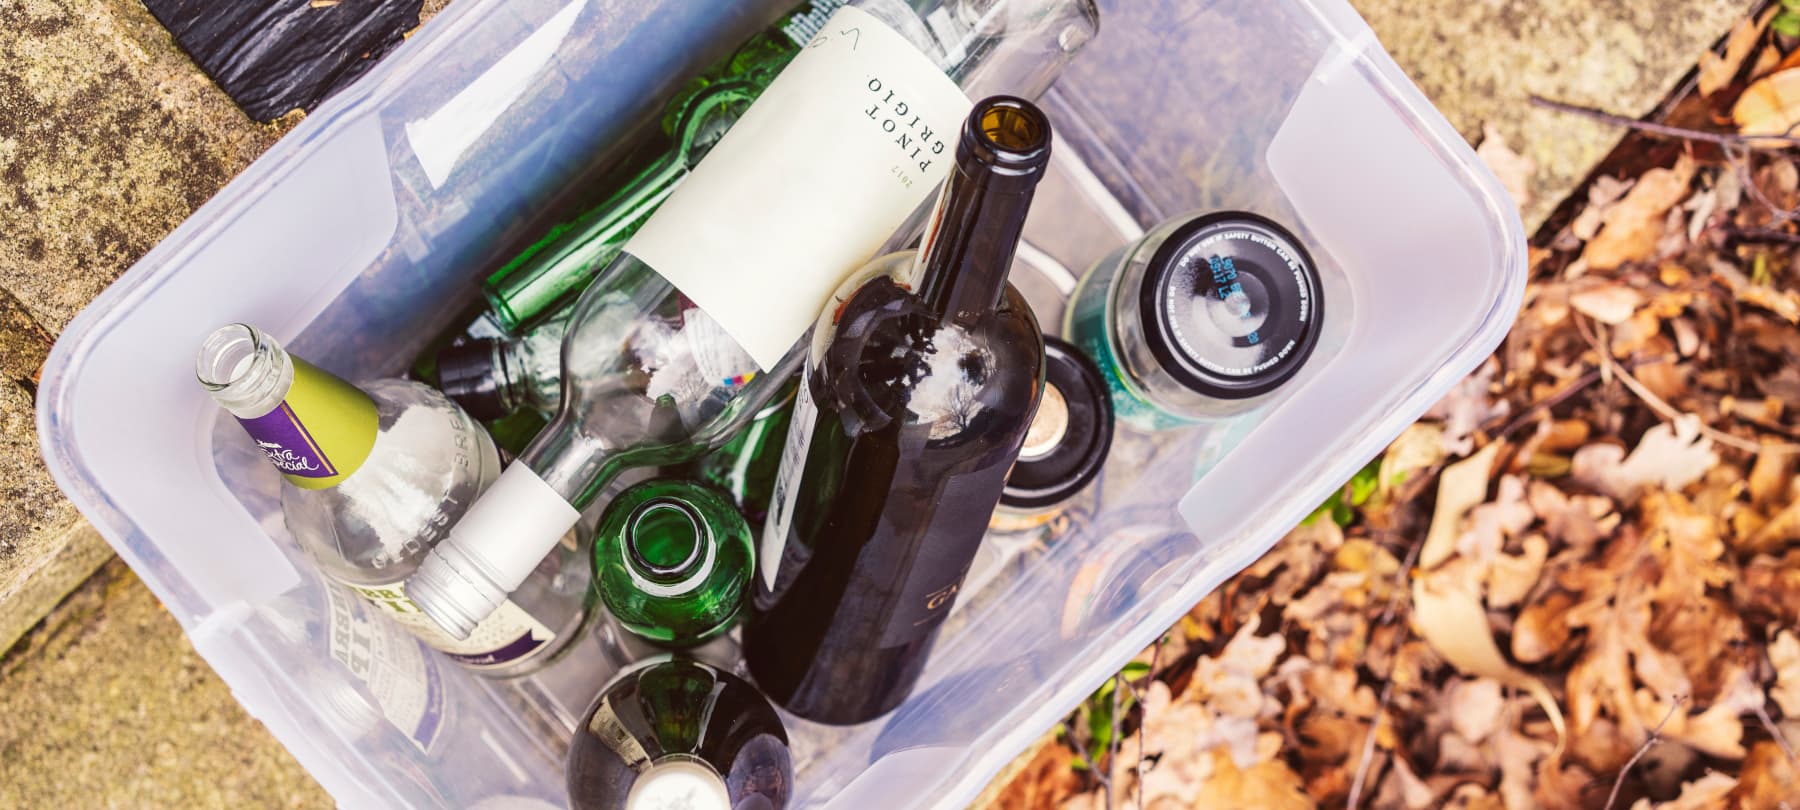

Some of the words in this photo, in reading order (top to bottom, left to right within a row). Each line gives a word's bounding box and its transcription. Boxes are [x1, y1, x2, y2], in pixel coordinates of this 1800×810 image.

[868, 78, 945, 155] GRIGIO
[865, 104, 932, 173] PINOT
[891, 165, 913, 188] 2017
[1223, 232, 1250, 240] SAFETY
[1250, 234, 1277, 251] BUTTON
[1276, 247, 1291, 262] CAN
[1293, 268, 1307, 298] PUSHED
[1299, 300, 1308, 322] DOWN
[1253, 356, 1279, 374] PUSHED
[1278, 339, 1296, 358] DOWN
